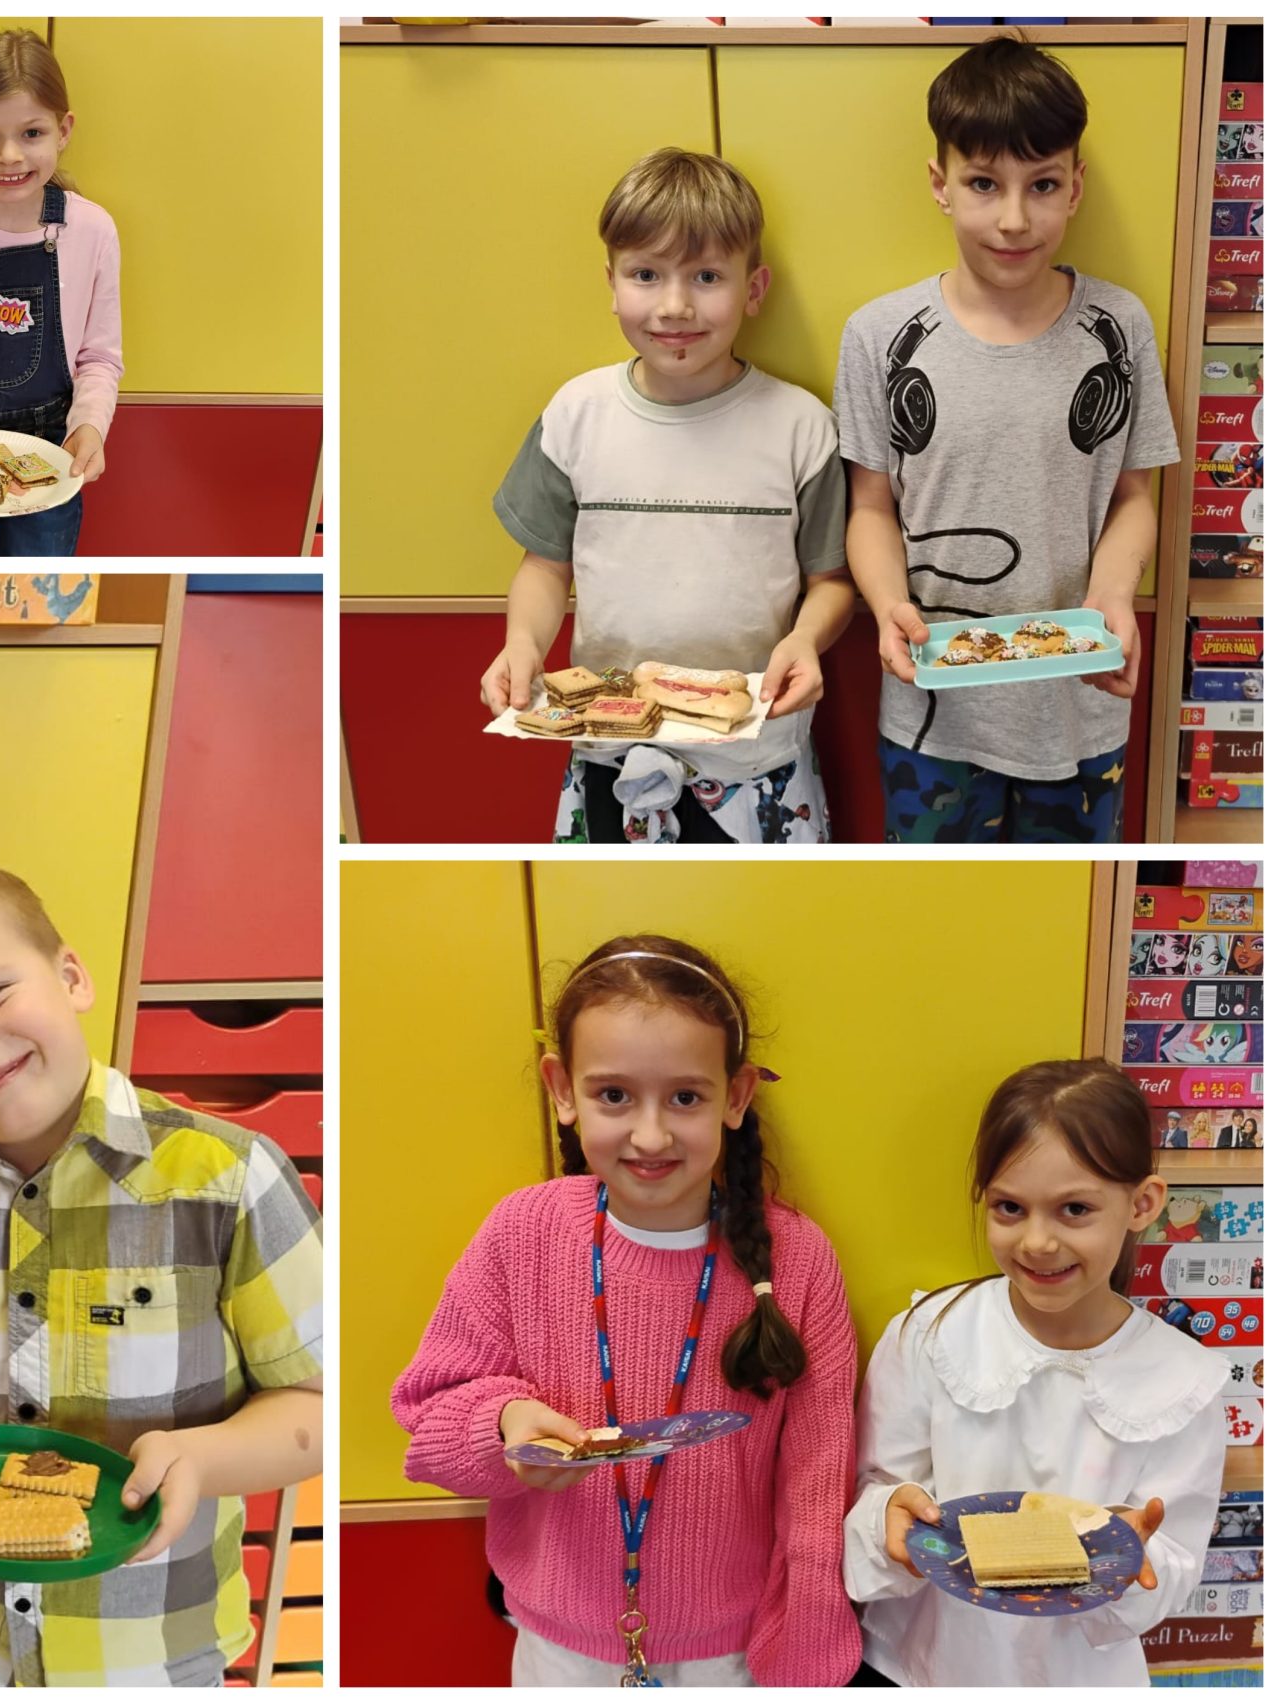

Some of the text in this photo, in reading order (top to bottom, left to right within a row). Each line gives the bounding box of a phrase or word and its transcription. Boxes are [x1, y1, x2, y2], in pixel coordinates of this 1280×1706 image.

[1231, 174, 1261, 190] Trefl
[1231, 249, 1261, 264] Trefl
[1207, 285, 1235, 300] Disney
[1206, 365, 1227, 375] Disney
[1215, 412, 1245, 427] Trefl
[1206, 504, 1234, 519] Trefl
[1200, 642, 1257, 657] SPIDER-MAN
[1140, 991, 1173, 1010] Trefl
[1139, 1078, 1171, 1096] Trefl
[701, 1265, 711, 1290] KAISAI
[1227, 1305, 1238, 1315] 35
[1195, 1317, 1211, 1329] 70
[1244, 1319, 1256, 1328] 48
[1220, 1327, 1232, 1337] 54
[681, 1350, 692, 1373] KAISAI
[1142, 1624, 1234, 1647] refl Puzzle
